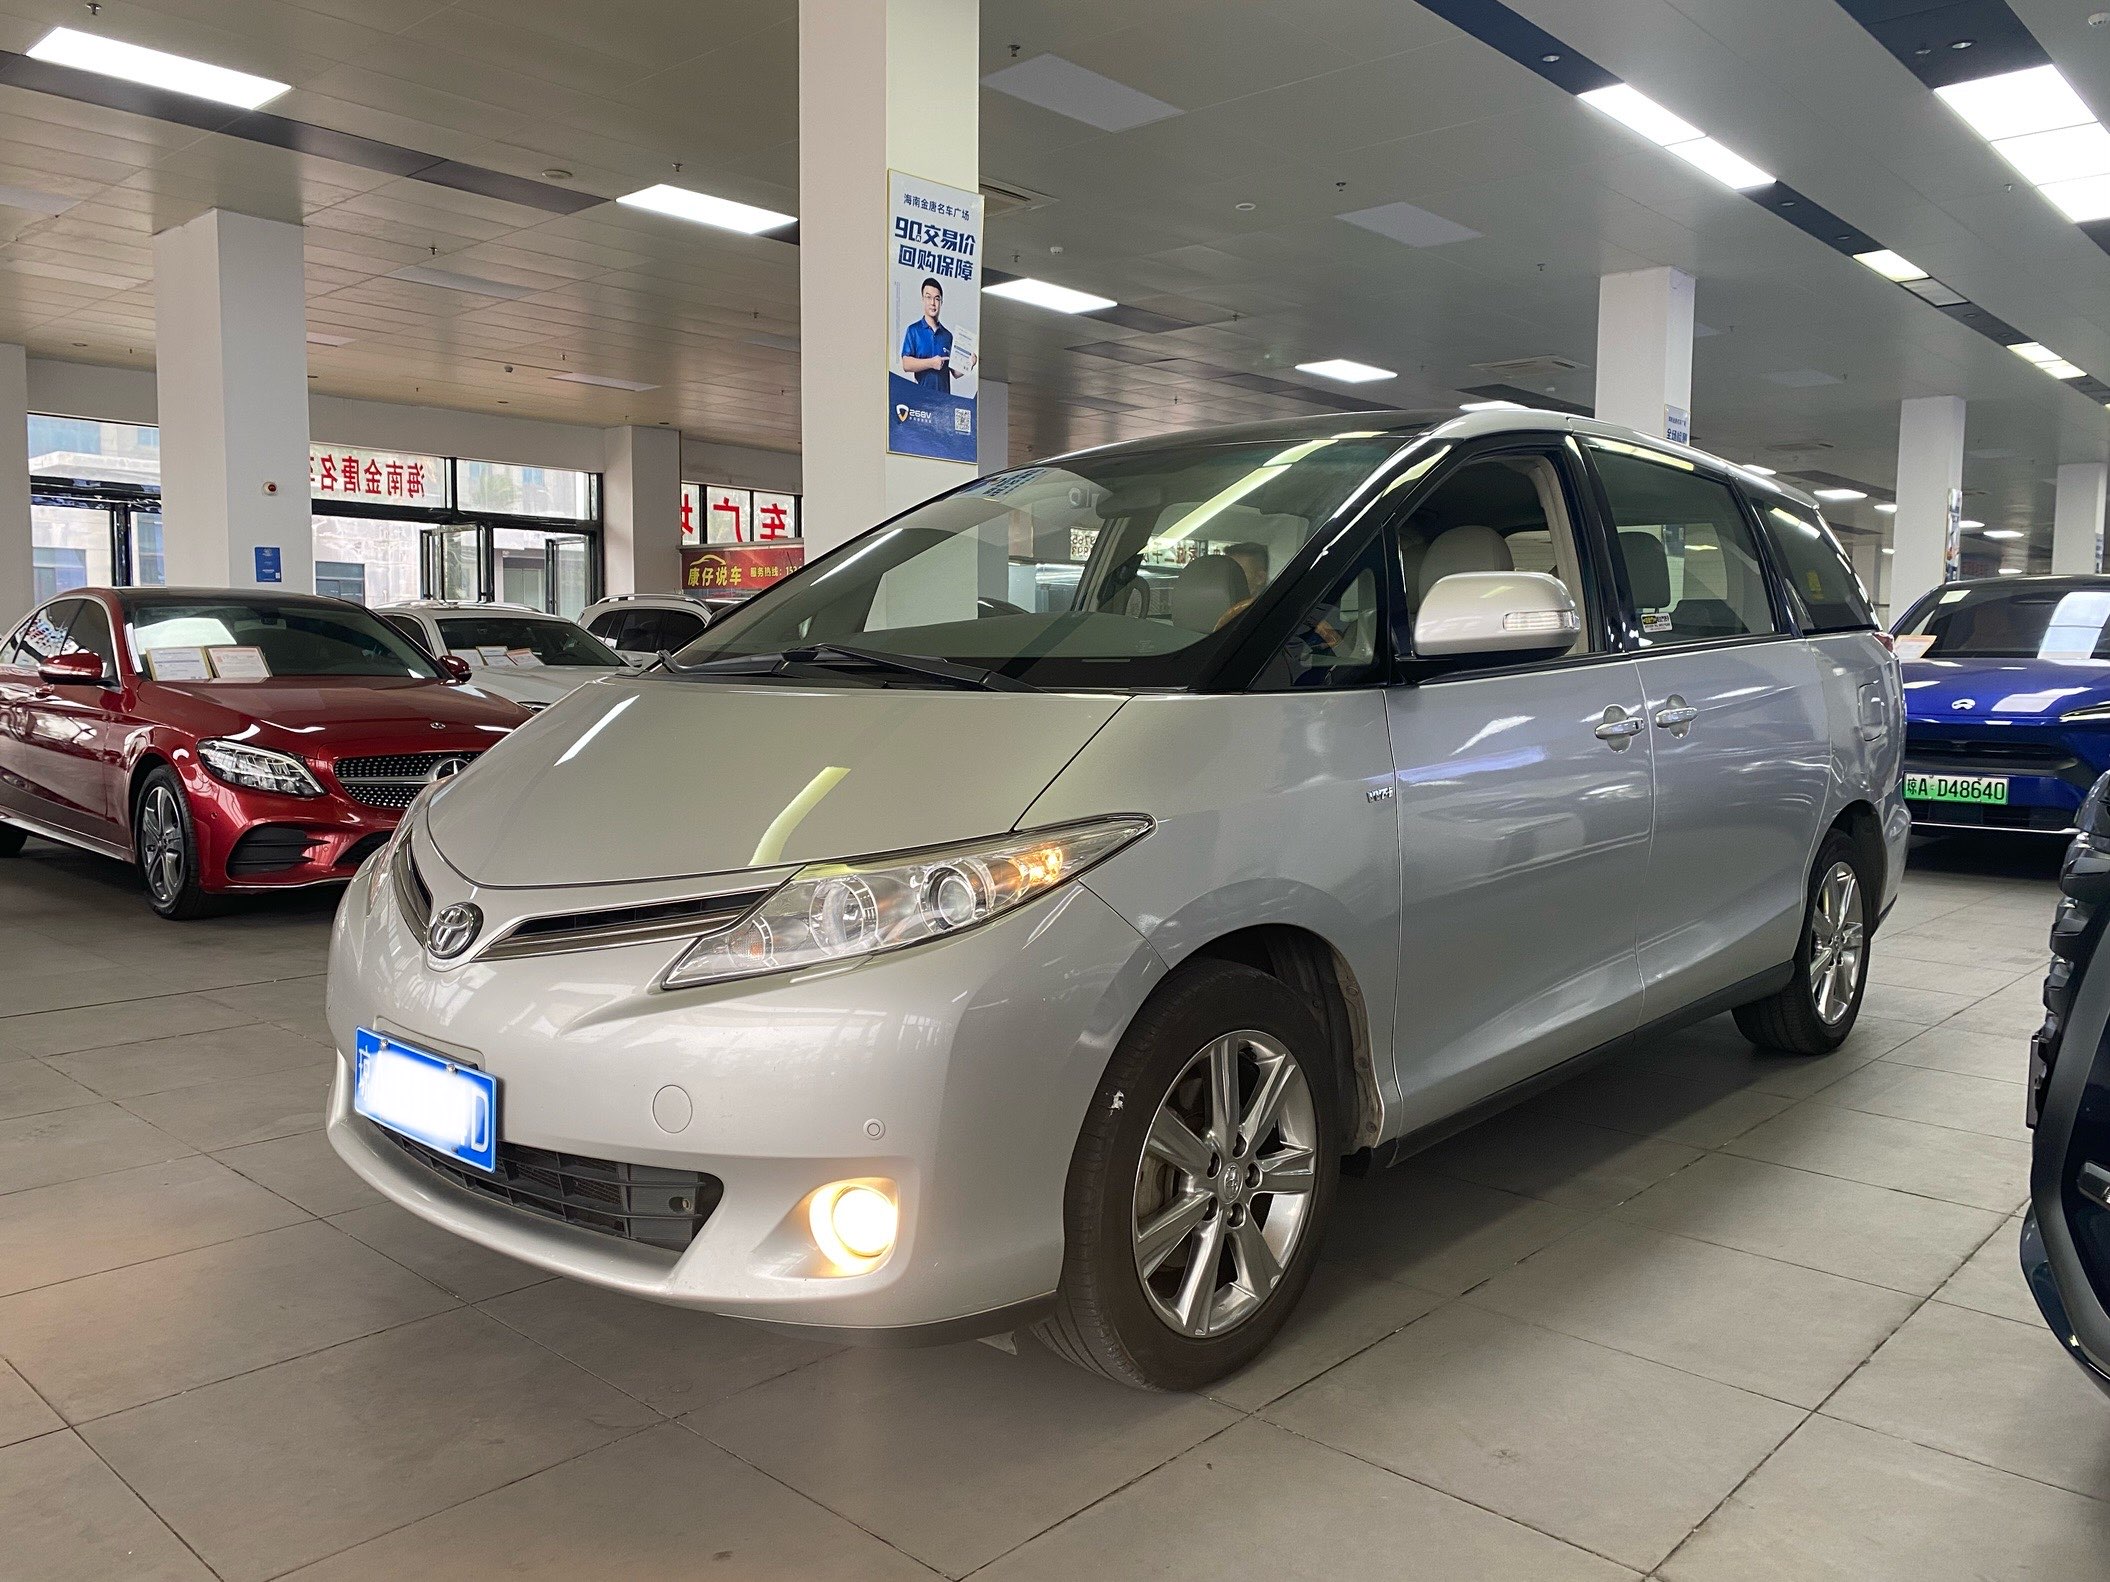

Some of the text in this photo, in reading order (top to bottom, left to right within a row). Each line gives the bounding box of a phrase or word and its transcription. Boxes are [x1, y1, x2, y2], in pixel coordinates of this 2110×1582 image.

[903, 193, 970, 221] 海南金唐名车广场
[898, 244, 974, 281] 回购保障
[687, 565, 742, 586] 康仔说车
